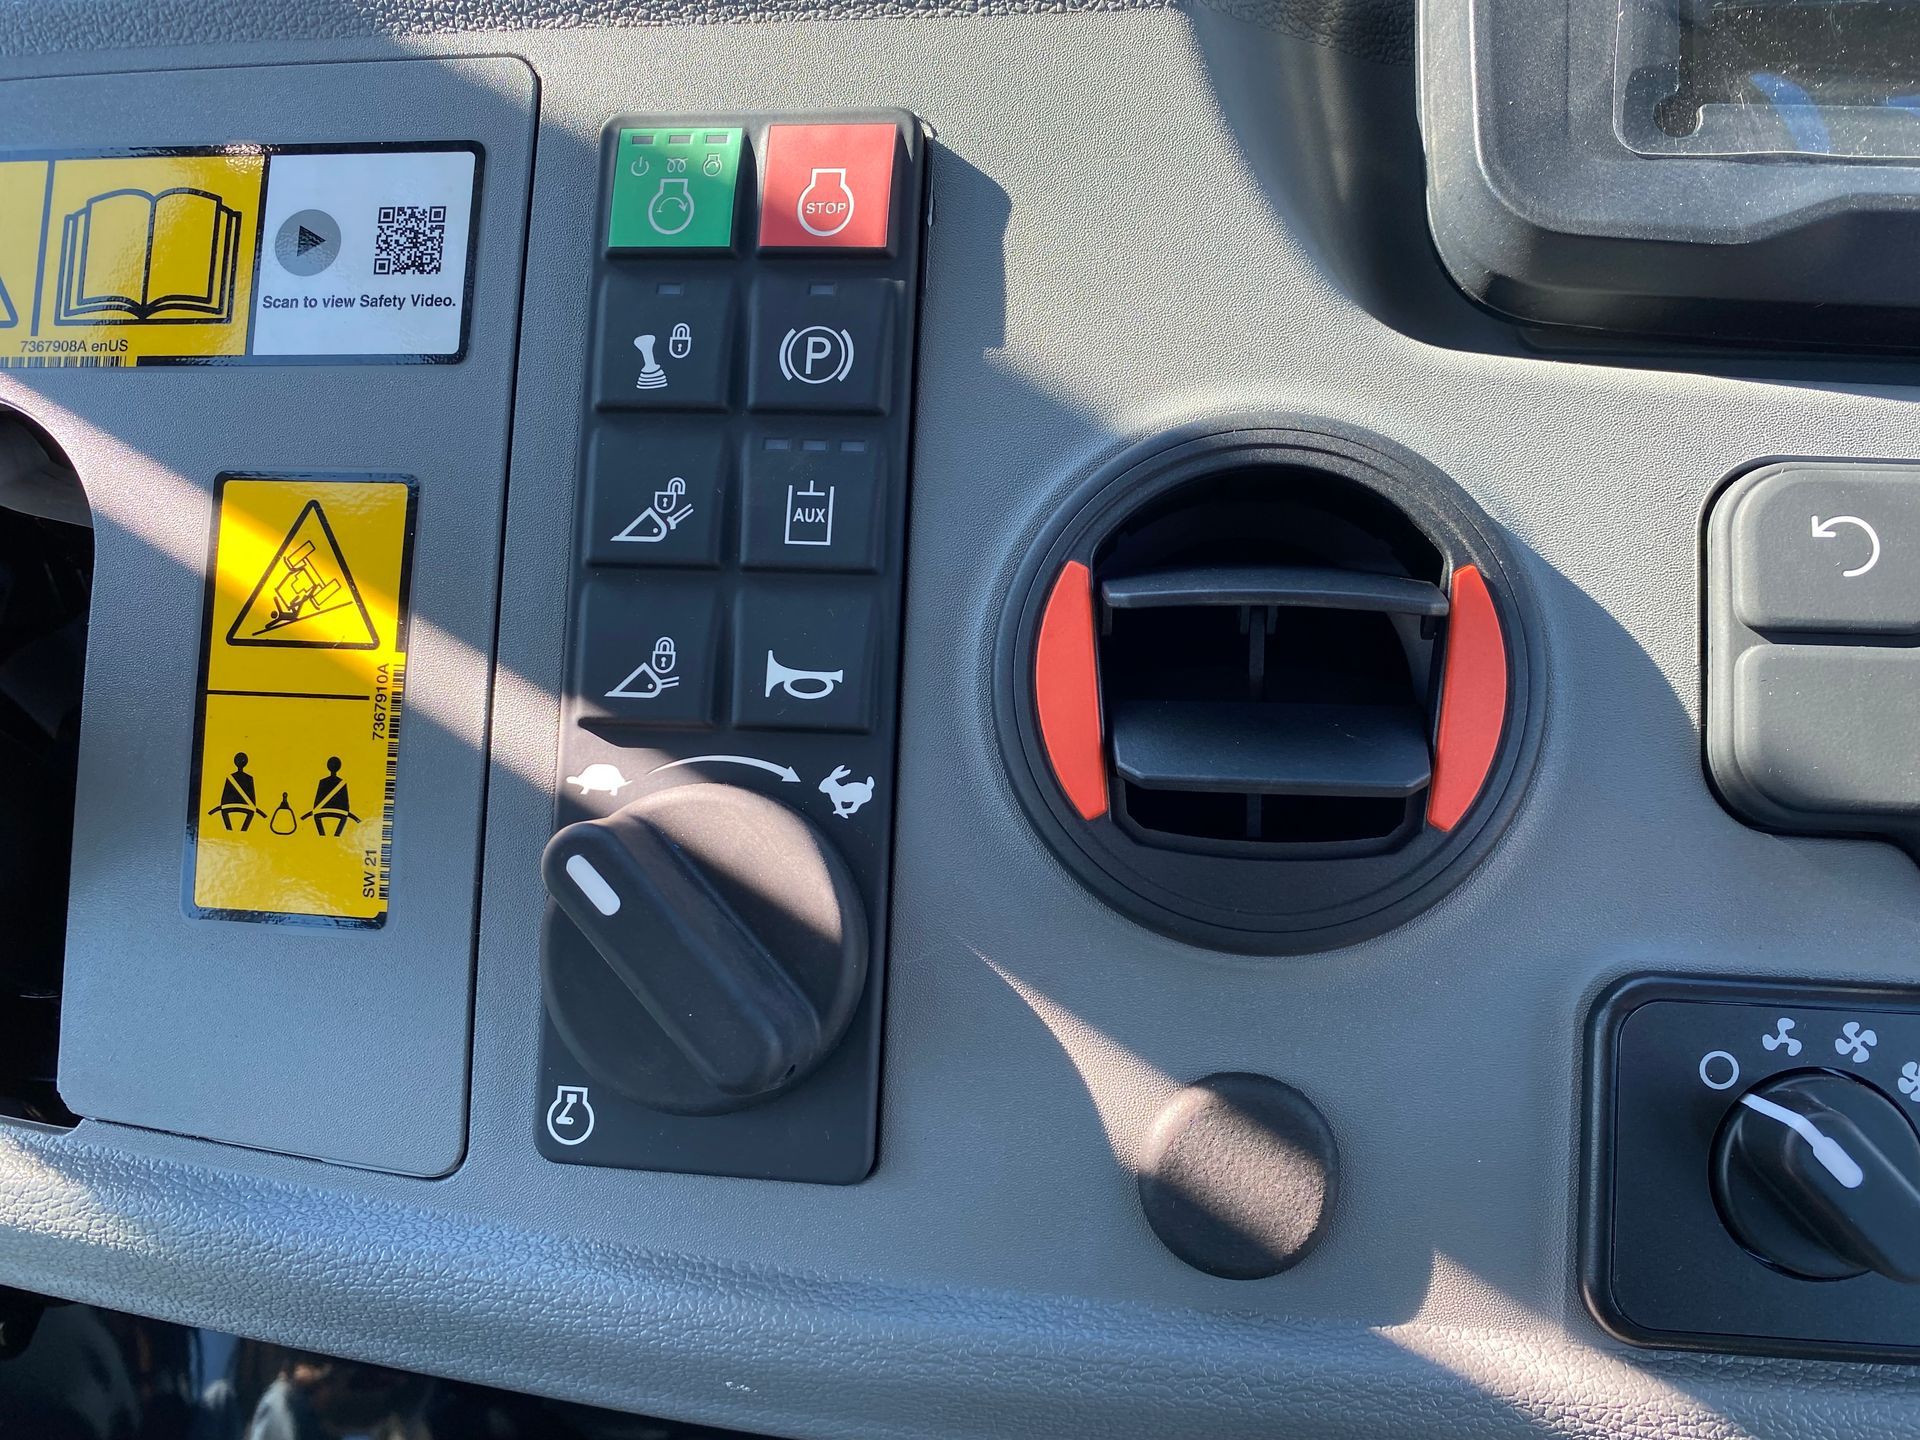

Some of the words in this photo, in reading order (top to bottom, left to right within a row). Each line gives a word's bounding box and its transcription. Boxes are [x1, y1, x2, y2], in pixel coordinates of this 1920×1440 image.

[806, 202, 847, 215] STOP
[262, 295, 299, 309] Scan
[303, 296, 318, 309] to
[322, 294, 356, 308] view
[359, 294, 406, 311] Safety
[410, 293, 457, 308] Video.
[21, 340, 87, 353] 7367908A
[91, 339, 129, 352] enUS
[805, 336, 832, 375] P
[792, 507, 826, 523] AUX
[372, 663, 390, 740] 7367910A
[364, 850, 377, 867] 21
[362, 870, 376, 898] SW
